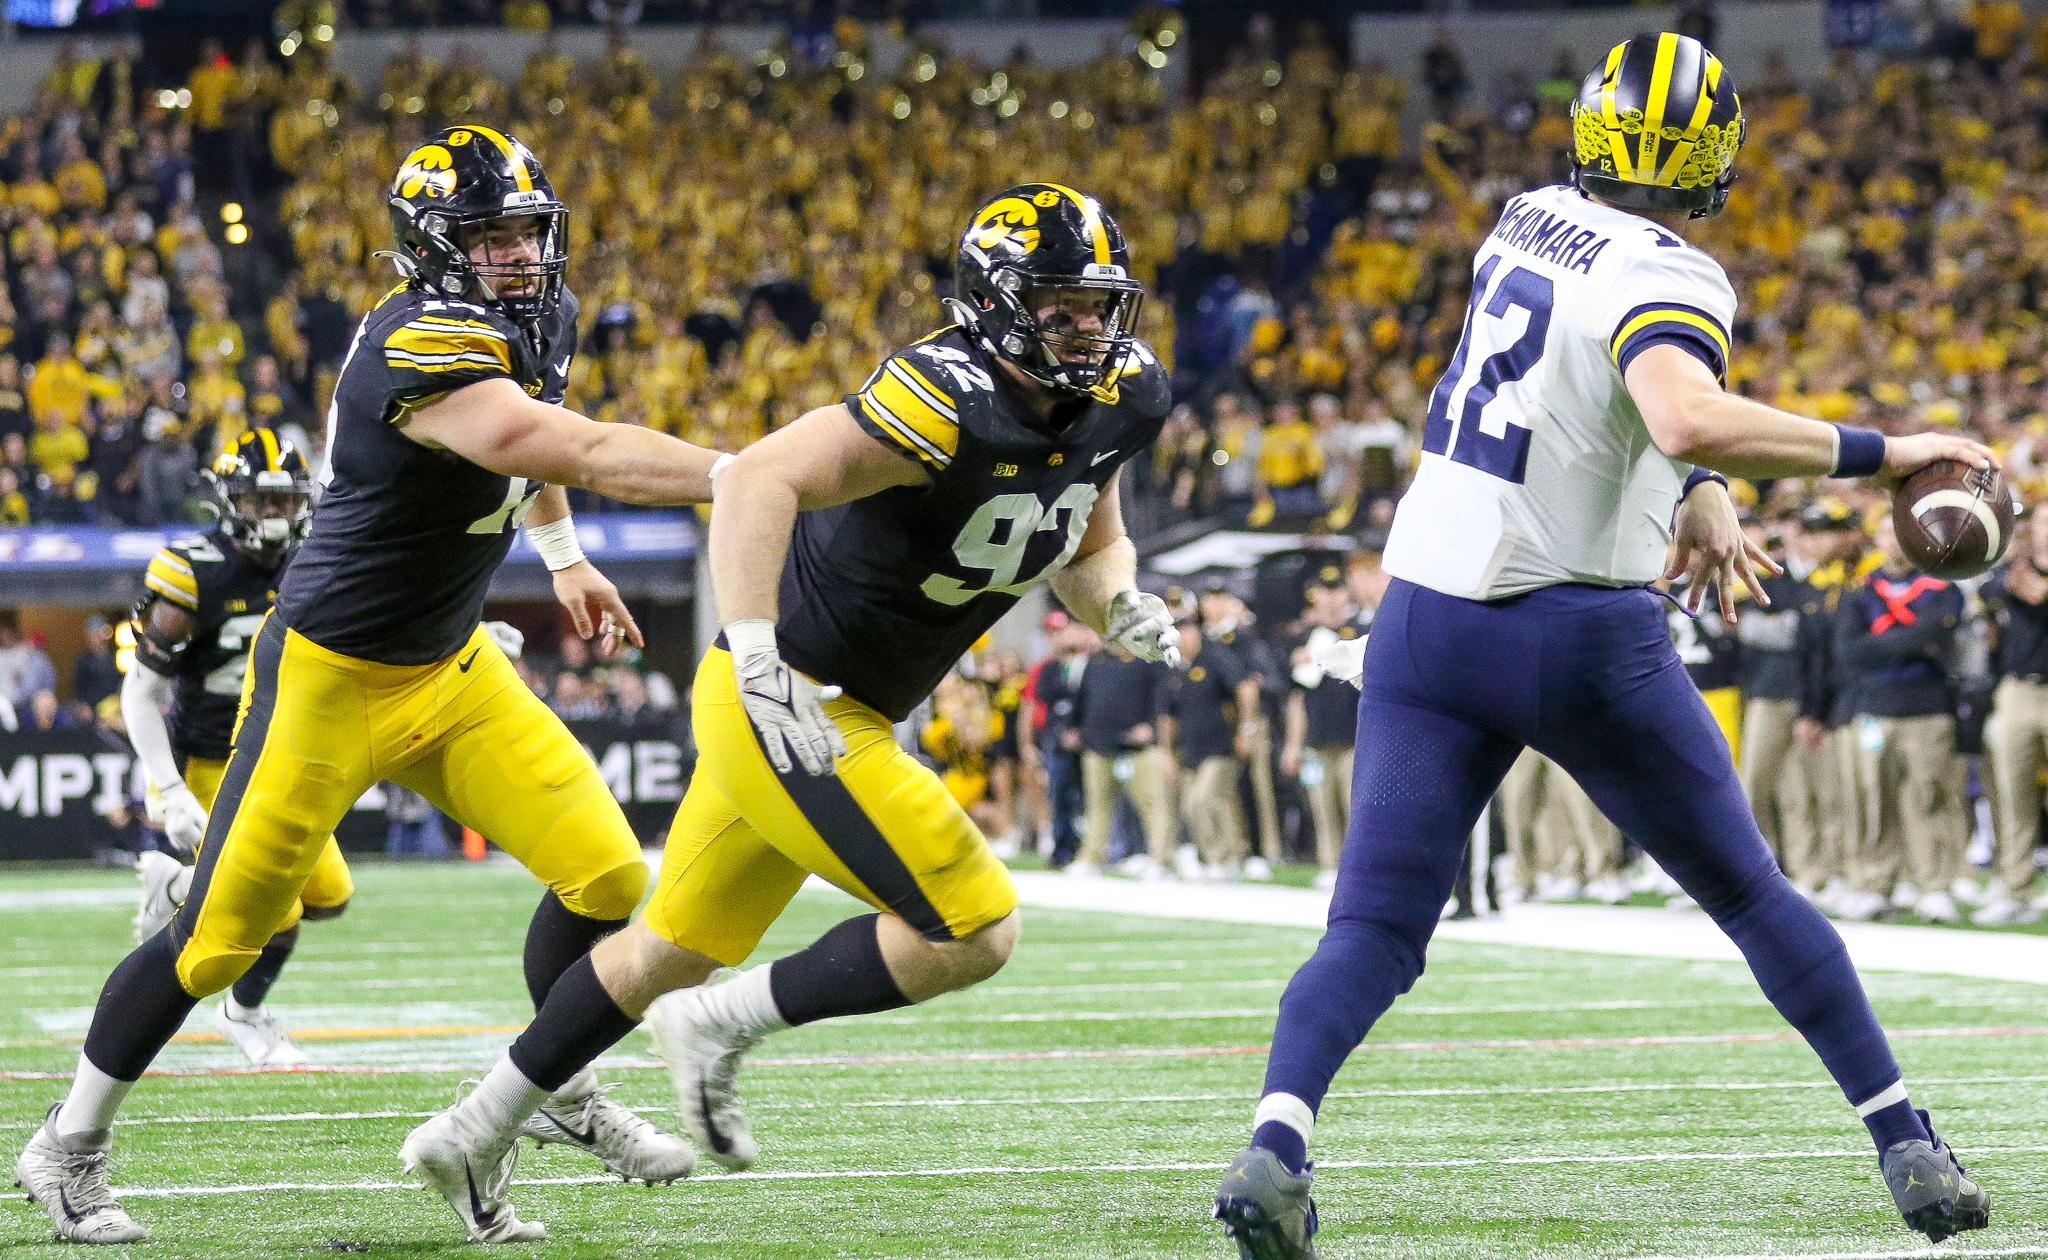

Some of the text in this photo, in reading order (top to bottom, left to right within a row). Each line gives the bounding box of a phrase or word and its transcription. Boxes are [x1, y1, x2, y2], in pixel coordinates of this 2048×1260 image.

[518, 192, 538, 203] IOWA
[1600, 158, 1612, 173] 12
[1493, 197, 1612, 275] McNAMARA
[1098, 265, 1118, 276] IOWA
[1421, 254, 1554, 485] 12
[920, 483, 1099, 606] 92
[203, 613, 266, 696] 2
[0, 752, 133, 818] MPI
[584, 739, 683, 805] ME
